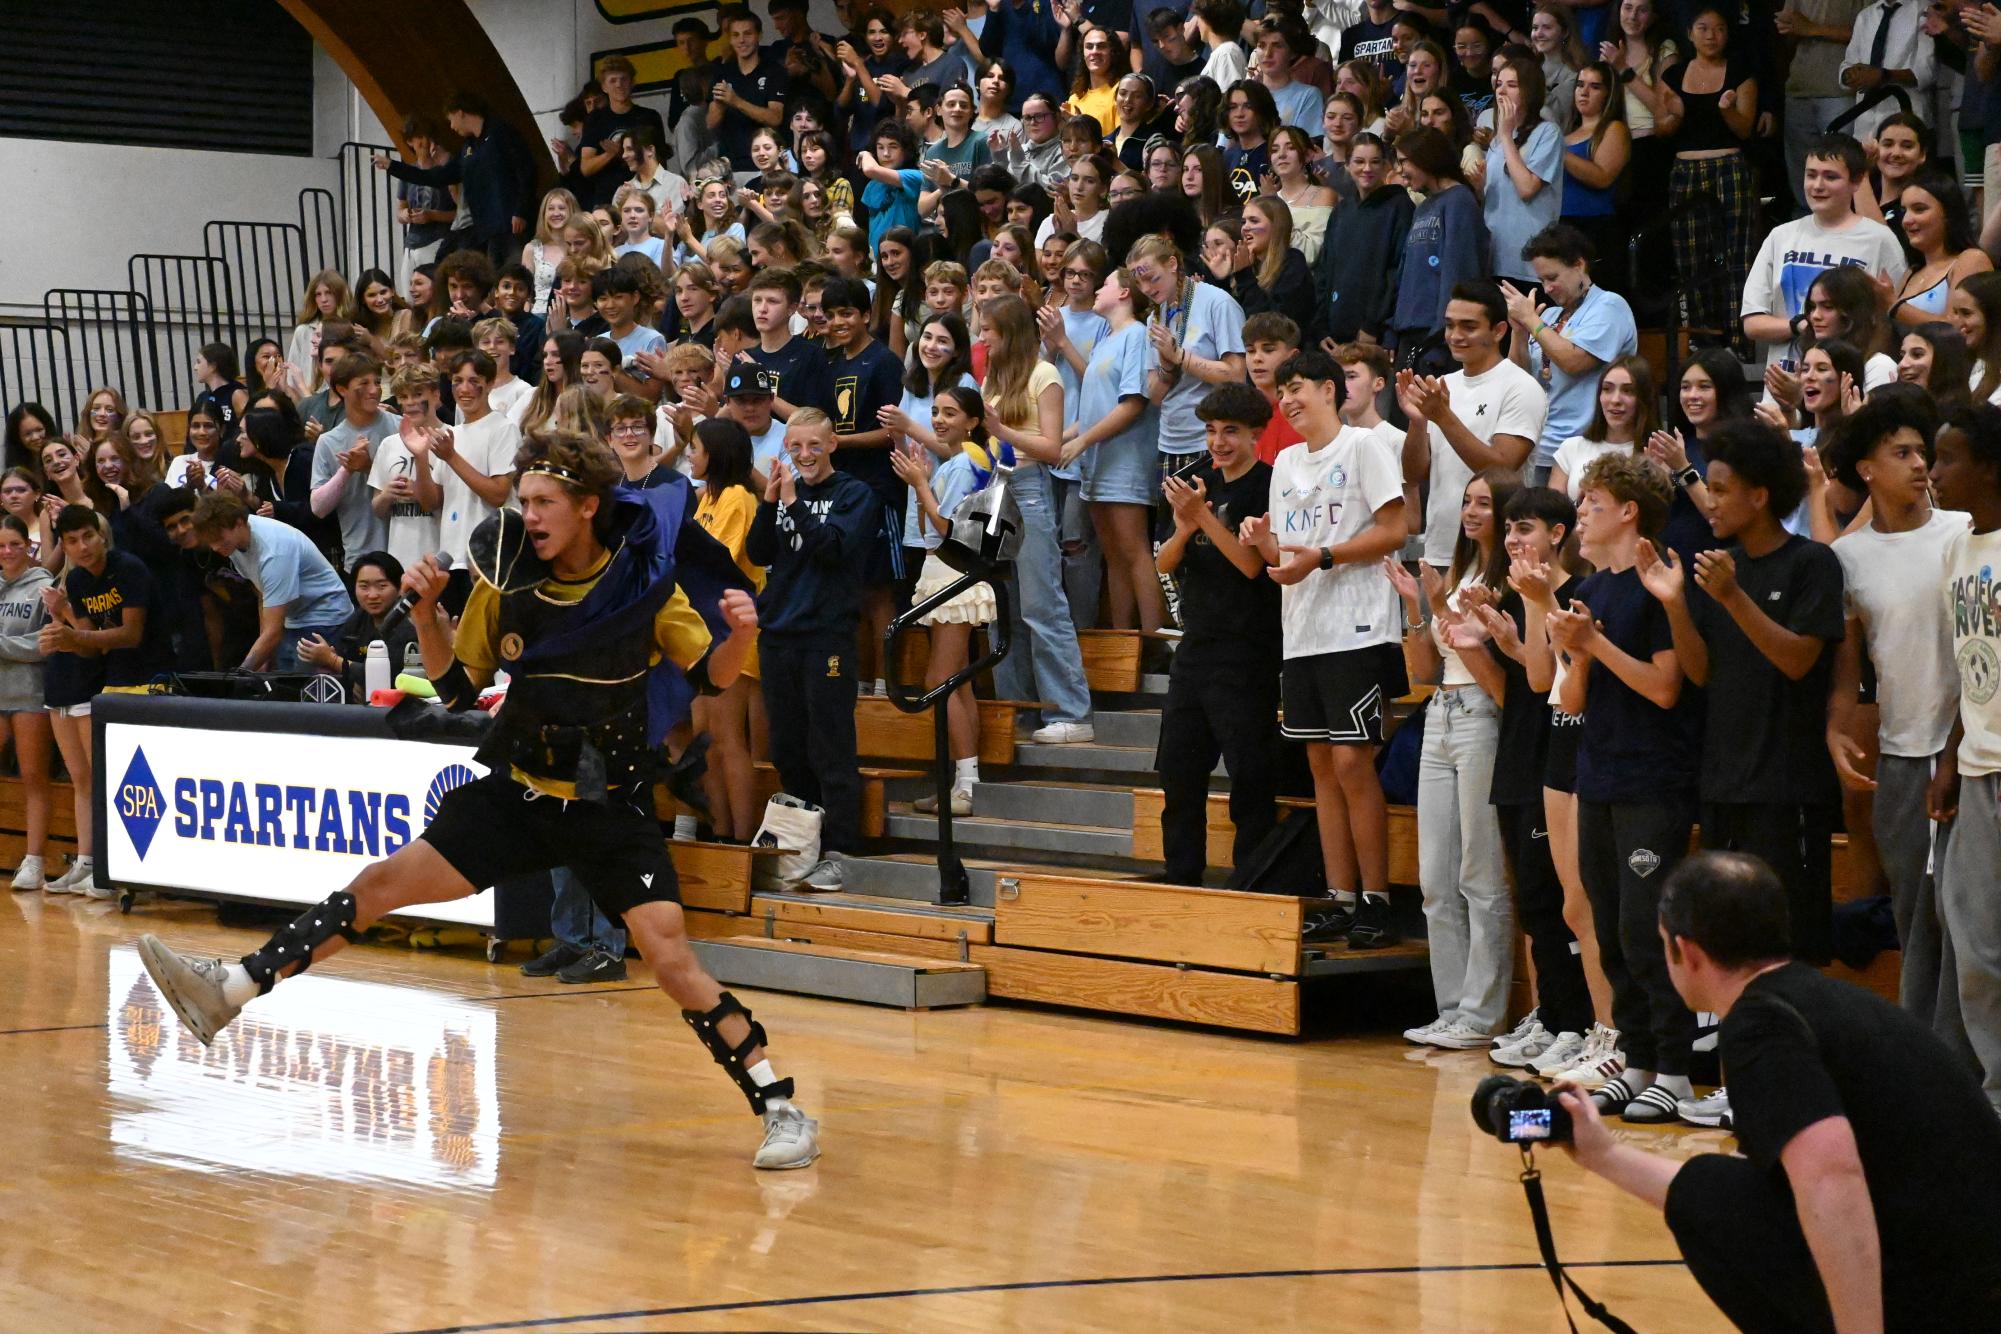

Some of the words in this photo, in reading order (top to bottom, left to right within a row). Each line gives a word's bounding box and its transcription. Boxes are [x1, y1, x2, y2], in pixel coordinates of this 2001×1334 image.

[1355, 39, 1394, 56] SPARTAN
[1783, 250, 1867, 270] BILLIE
[123, 784, 160, 819] SPA
[174, 776, 412, 858] SPARTANS
